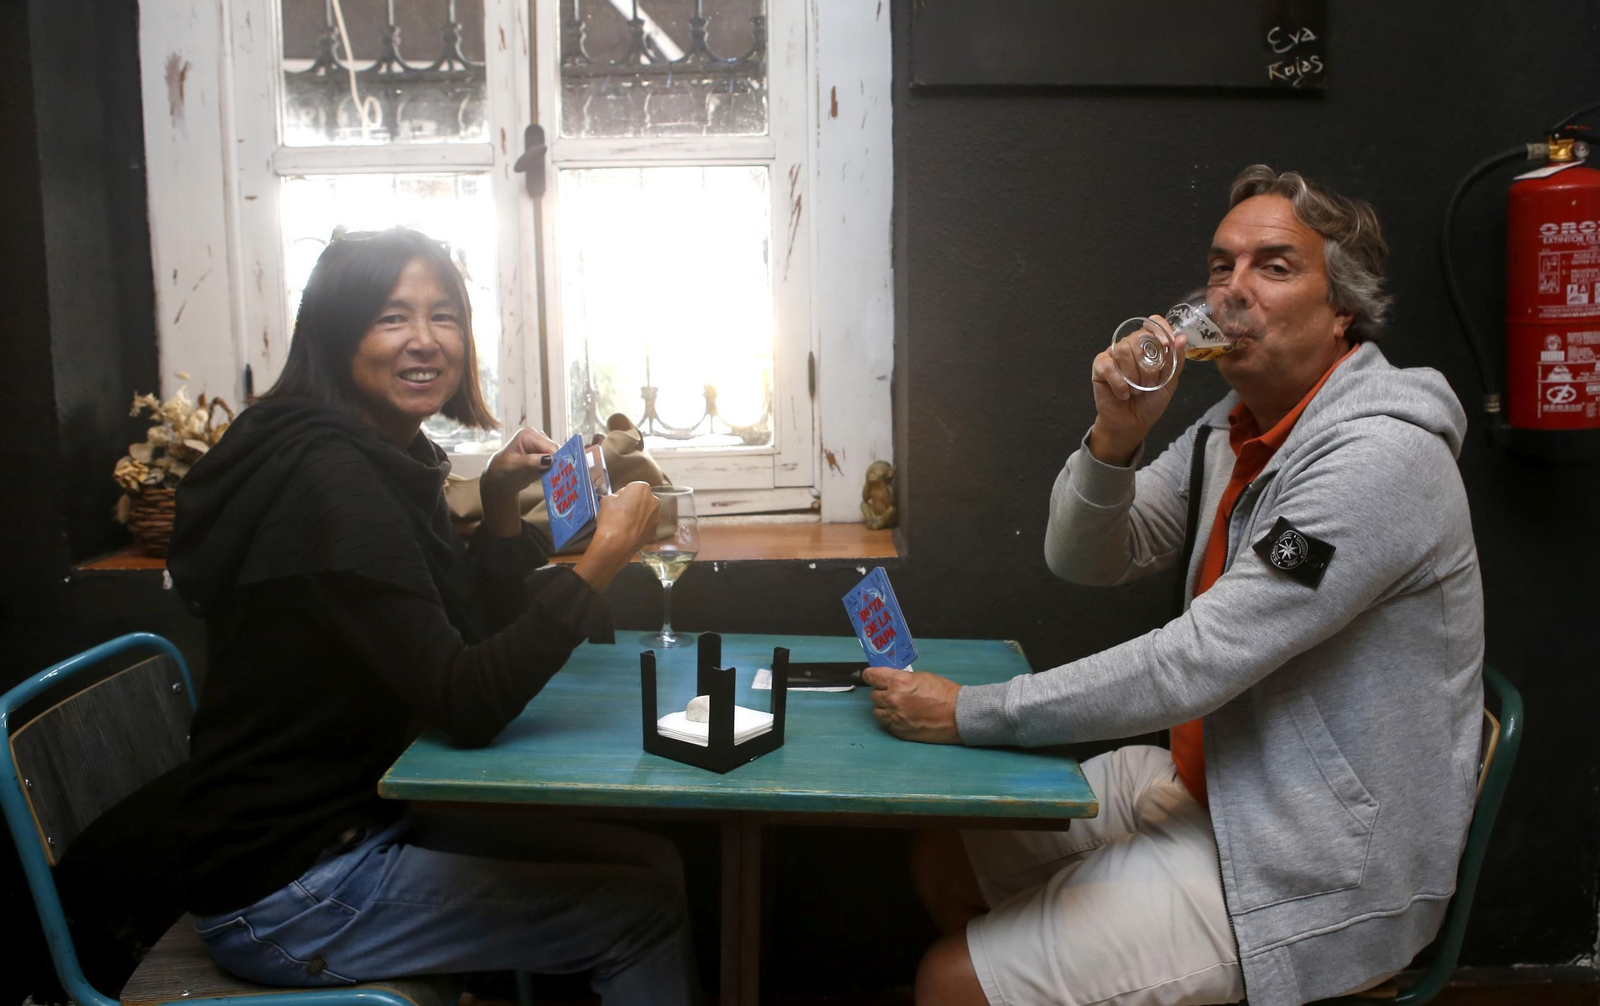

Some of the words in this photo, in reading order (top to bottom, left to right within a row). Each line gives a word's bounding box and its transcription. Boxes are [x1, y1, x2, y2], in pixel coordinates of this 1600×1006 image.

[1267, 26, 1318, 53] Eva
[1267, 55, 1323, 87] Rojas
[552, 485, 565, 503] DE
[565, 475, 577, 491] LA
[556, 492, 578, 515] TAPA
[864, 621, 880, 638] DE
[877, 610, 892, 628] LA
[871, 626, 897, 650] TAPA
